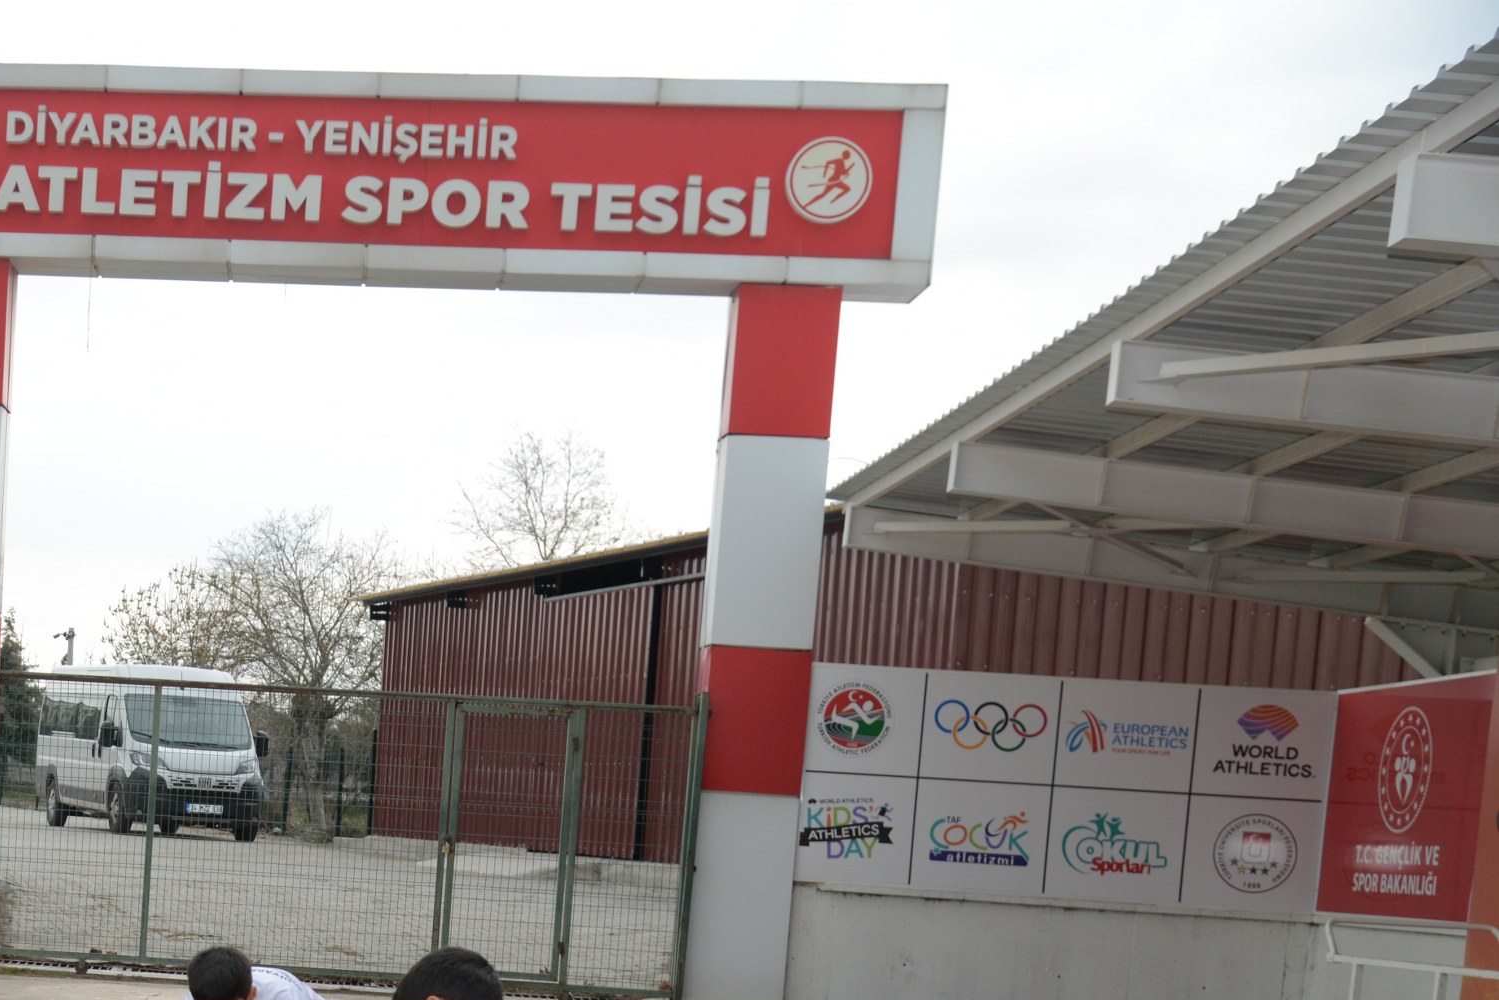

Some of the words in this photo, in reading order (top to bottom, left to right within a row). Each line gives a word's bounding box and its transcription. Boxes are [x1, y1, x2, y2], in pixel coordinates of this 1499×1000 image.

[6, 104, 258, 152] DİYARBAKIR
[295, 114, 519, 165] YENİŞEHİR
[340, 174, 531, 230] SPOR
[550, 173, 771, 238] TESİSİ
[1112, 722, 1190, 738] EUROPEAN
[1111, 735, 1188, 750] ATHLETICS
[1232, 743, 1299, 761] WORLD
[1212, 759, 1312, 779] ATHLETICS
[946, 815, 962, 824] TAF
[807, 823, 880, 841] ATHLETICS
[826, 836, 878, 860] DAY
[1065, 832, 1168, 869] OKUL
[1355, 844, 1373, 865] T.C.
[1375, 840, 1423, 870] GENÇLİK
[1425, 845, 1441, 867] VE
[946, 851, 1016, 866] atletizmi
[1351, 872, 1379, 893] SPOR
[1379, 870, 1438, 897] BAKANLIĞI
